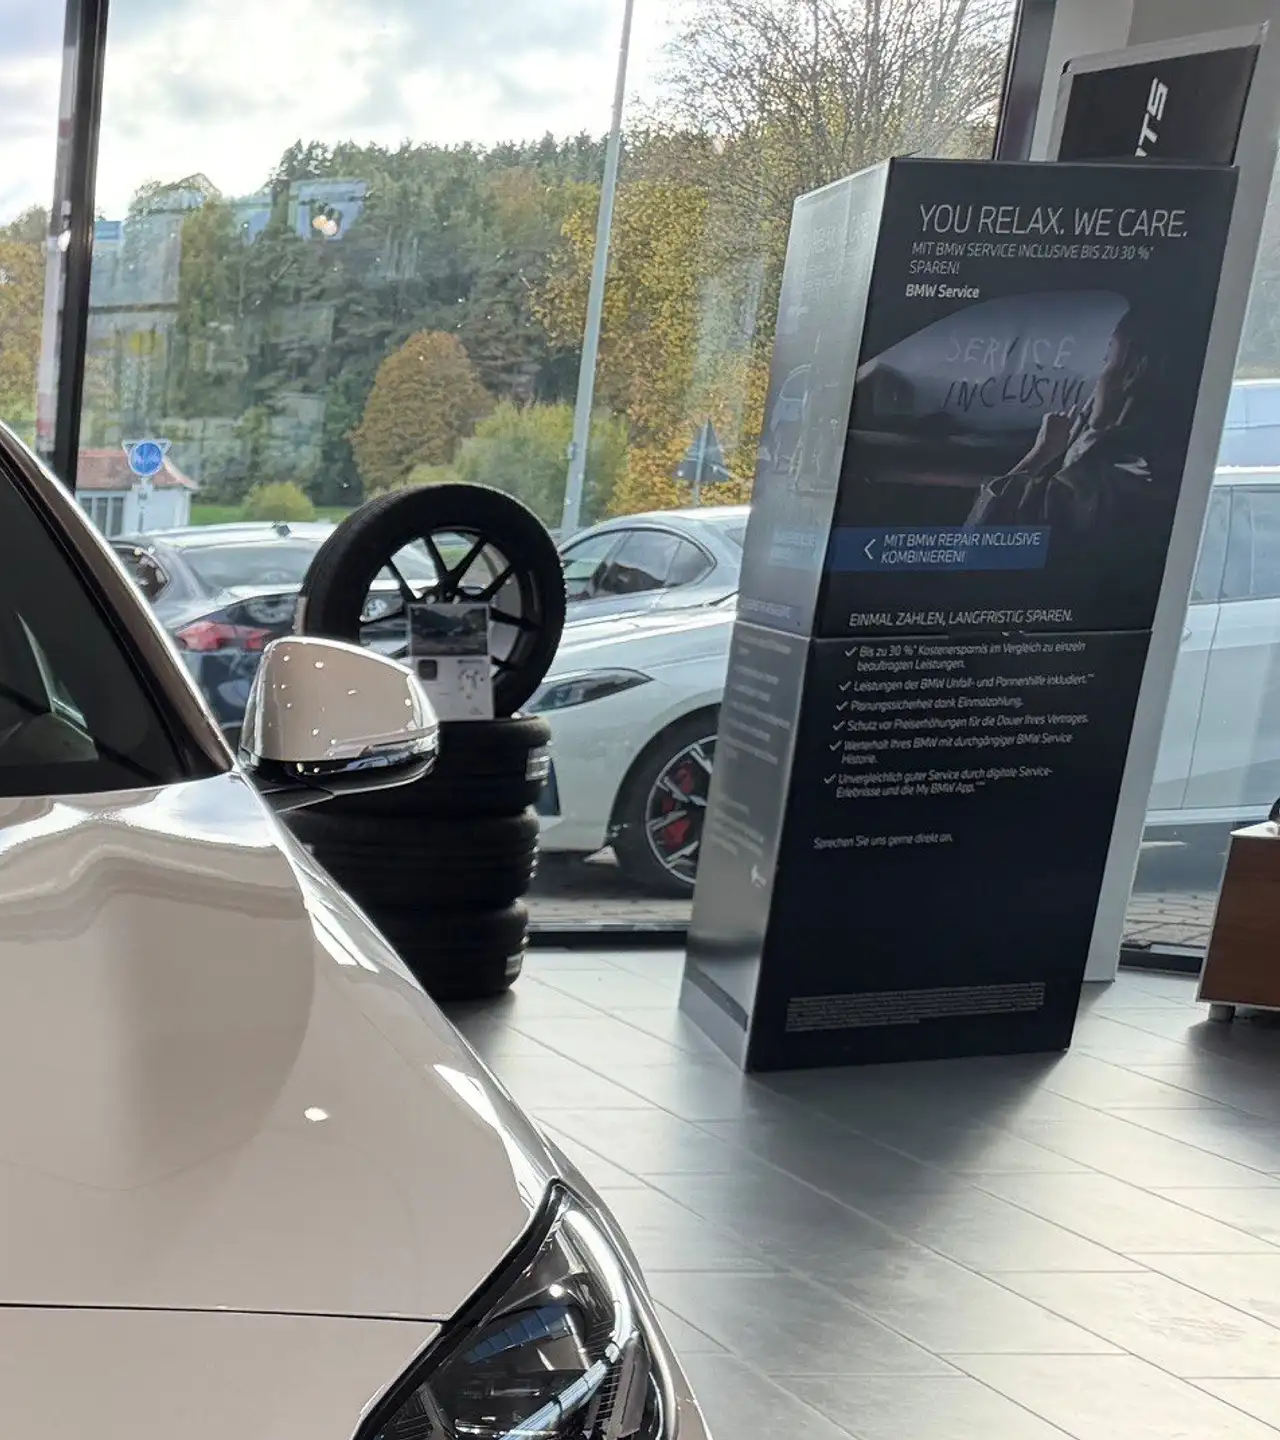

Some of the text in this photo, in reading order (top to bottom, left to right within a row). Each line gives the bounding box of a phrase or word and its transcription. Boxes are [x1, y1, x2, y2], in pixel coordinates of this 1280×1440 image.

[919, 204, 1188, 238] YOU RELAX. WE CARE.
[912, 241, 935, 255] MIT
[936, 242, 966, 256] BMW
[967, 243, 1017, 258] SERVICE
[1018, 243, 1080, 259] INCLUSIVE
[1081, 244, 1101, 259] BIS
[1102, 245, 1121, 260] ZU
[1122, 245, 1136, 260] 30
[909, 260, 961, 275] SPAREN!
[905, 283, 980, 299] BMW Service
[946, 334, 1076, 374] SERVICE
[883, 532, 1042, 548] MIT BMW REPAIR INCLUSIVE
[880, 550, 966, 564] KOMBINIEREN!
[849, 609, 1073, 627] EINMAL ZAHLEN, LANGFRISTIG SPAREN.
